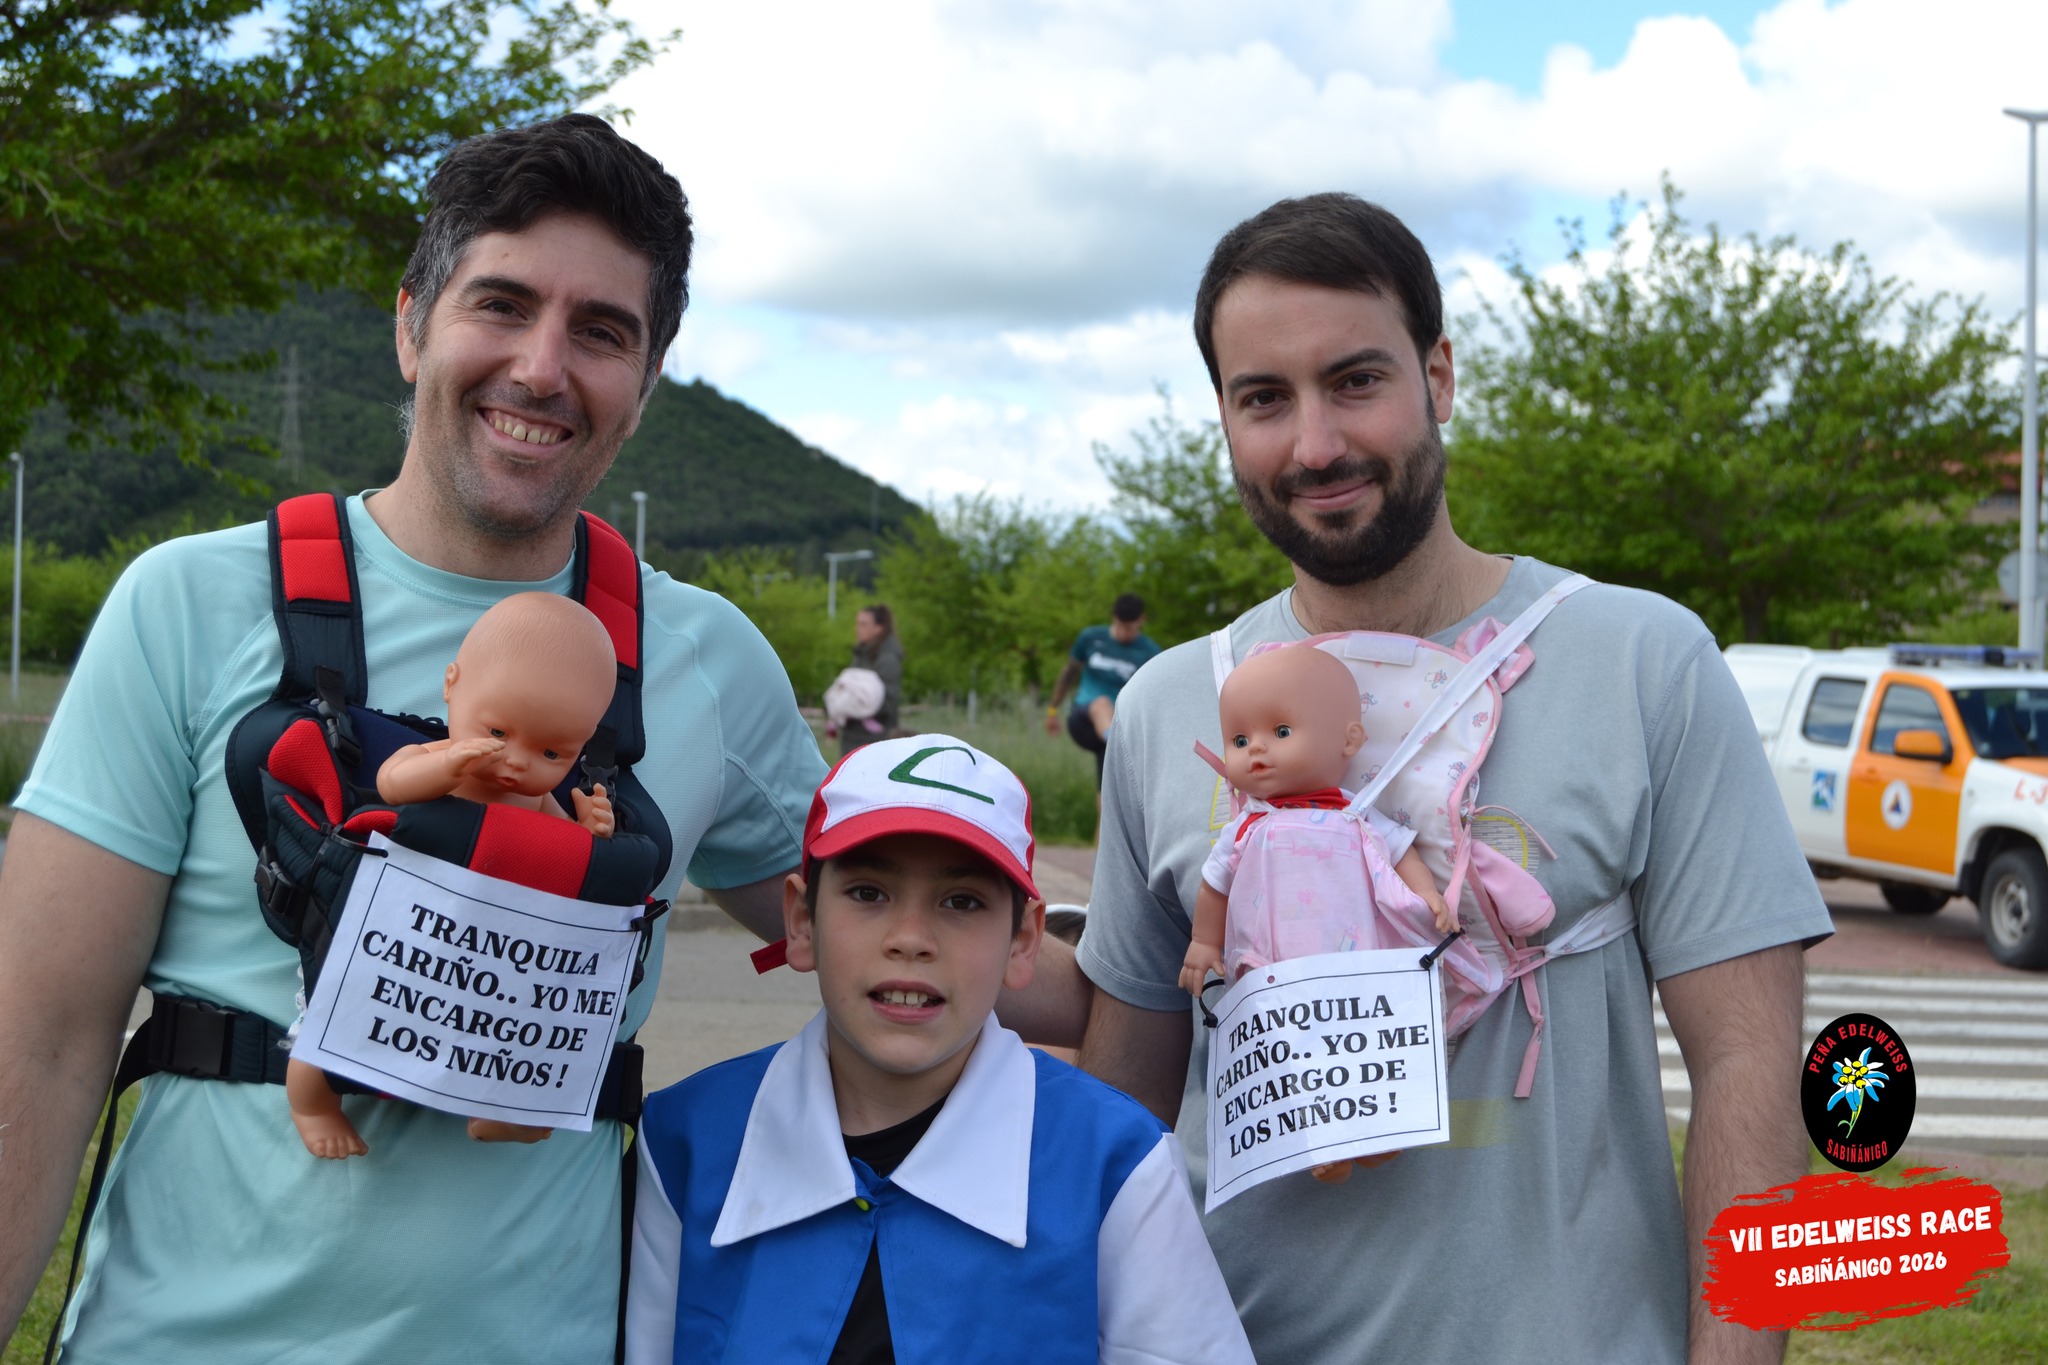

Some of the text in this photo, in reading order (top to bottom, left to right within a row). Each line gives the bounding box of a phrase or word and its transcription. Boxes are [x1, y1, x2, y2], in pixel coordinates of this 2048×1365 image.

[362, 929, 616, 1016] CARIÑO.. YO ME
[410, 904, 600, 976] TRANQUILA
[368, 1017, 441, 1062] LOS
[371, 975, 588, 1052] ENCARGO DE
[1228, 995, 1394, 1053] TRANQUILA
[1216, 1024, 1429, 1099] CARIÑO.. YO ME
[1224, 1059, 1406, 1126] ENCARGO DE
[1230, 1119, 1271, 1158] LOS
[1278, 1094, 1378, 1136] NIÑOS
